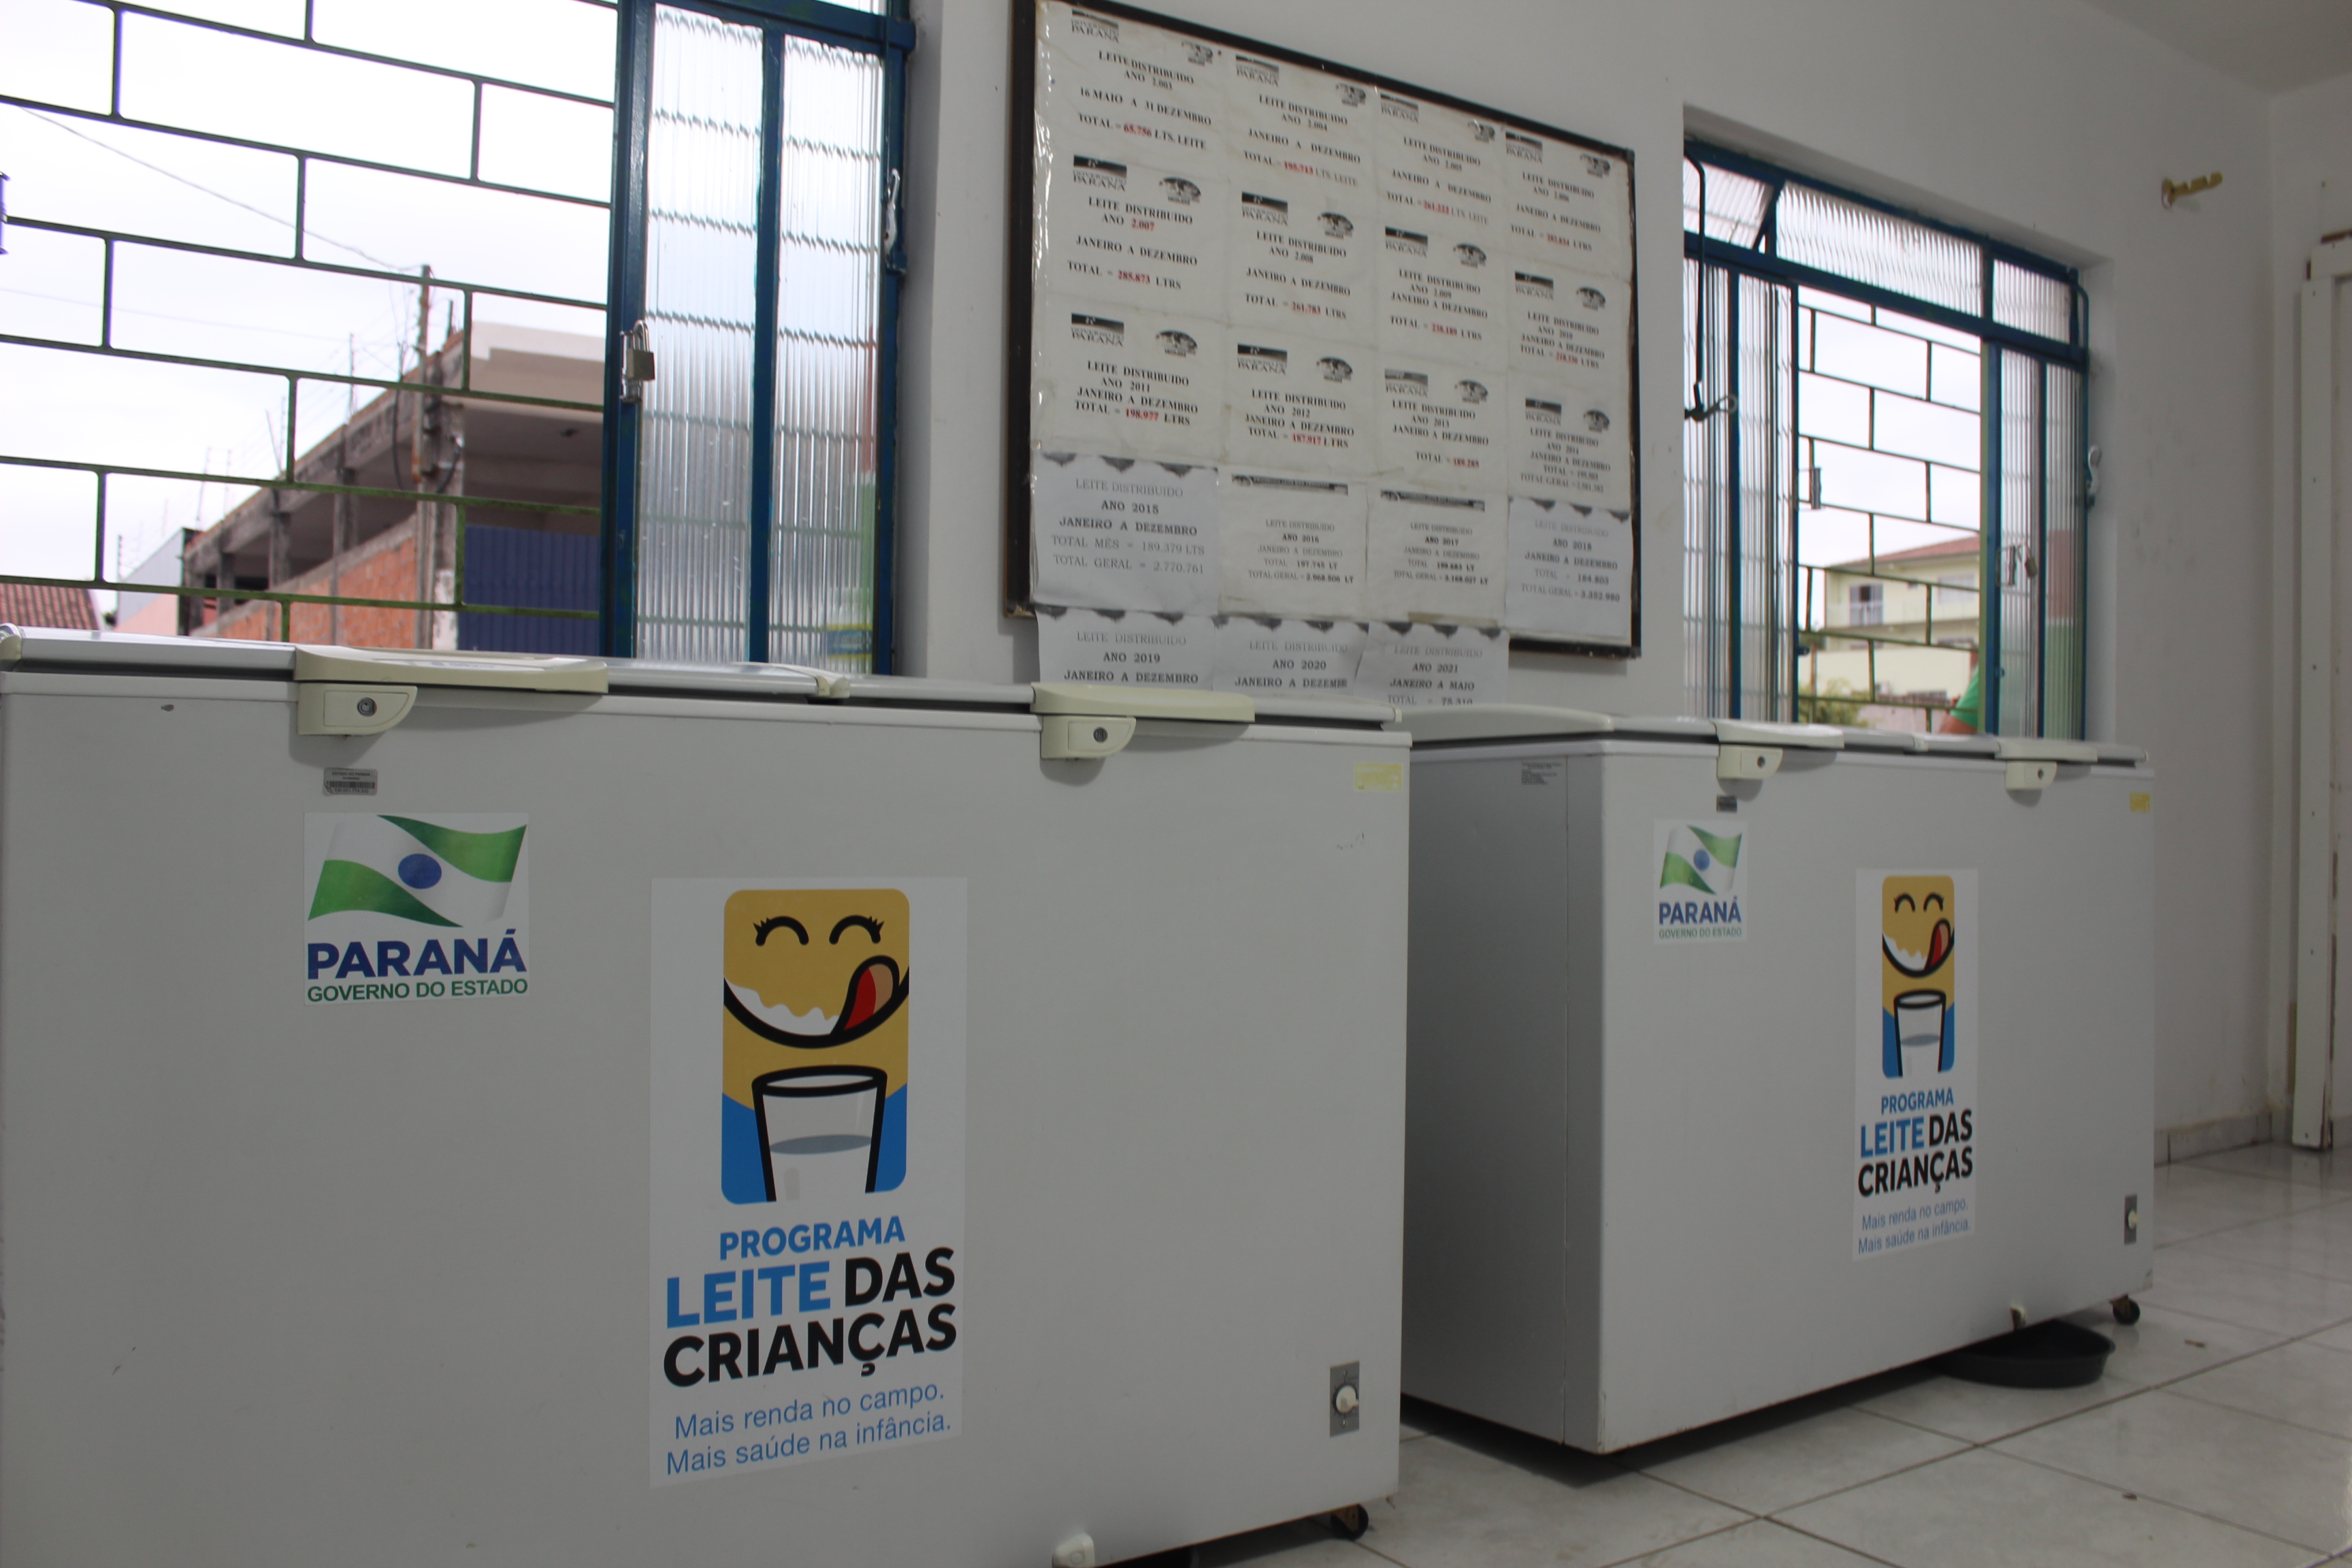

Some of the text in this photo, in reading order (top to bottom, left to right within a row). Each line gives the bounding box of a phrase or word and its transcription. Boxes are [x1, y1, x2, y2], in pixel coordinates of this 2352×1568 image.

[1099, 50, 1194, 84] LEITE DISTRIBUIDO
[1125, 70, 1172, 91] ANO 2.003
[1081, 86, 1211, 125] 16 MAIO 31 DEZEMBRO
[1260, 94, 1348, 125] LEITE DISTRIBUIDO
[1078, 112, 1113, 129] TOTAL
[1178, 135, 1206, 150] LEITE
[1282, 113, 1328, 131] ANO 2.004
[1248, 129, 1360, 163] JANEIRO DEZEMBRO
[1243, 150, 1275, 166] TOTAL
[1423, 154, 1439, 165] ANO
[1089, 196, 1193, 225] LEITE DISTRIBUIDO
[1102, 213, 1155, 231] ANO 2.007
[1076, 235, 1197, 266] JANEIRO DEZEMBRO
[1257, 230, 1347, 258] LEITE DISTRIBUIDO
[1269, 246, 1313, 264] ANO 2.008
[1067, 260, 1102, 276] TOTAL
[1156, 276, 1181, 289] LTRS
[1247, 267, 1350, 297] JANEIRO DEZEMBRO
[1399, 268, 1422, 282] LEITE
[1411, 284, 1428, 294] ANO
[1245, 293, 1277, 306] TOTAL
[1391, 292, 1428, 307] JANEIRO
[1390, 315, 1420, 329] TOTAL
[1088, 360, 1189, 387] LEITE DISTRIBUIDO
[1102, 377, 1150, 393] ANO 2011
[1077, 387, 1198, 414] JANEIRO DEZEMBRO
[1252, 388, 1345, 410] LEITE DISTRIBUIDO
[1075, 399, 1109, 414] TOTAL
[1164, 413, 1190, 426] LTRS
[1265, 404, 1310, 419] ANO 2012
[1392, 399, 1475, 420] LEITE DISTRIBUIDO
[1245, 413, 1354, 437] JANEIRO DEZEMBRO
[1411, 415, 1450, 428] ANO 2013
[1248, 427, 1348, 448] TOTAL LTRS
[1393, 425, 1488, 446] JANEIRO DEZEMBRO
[1416, 452, 1442, 463] TOTAL
[1076, 478, 1183, 497] LEITE DISTRIBUIDO
[1102, 500, 1158, 514] ANO 2015
[1060, 517, 1197, 536] JANEIRO A DEZEMBRO
[1266, 519, 1287, 528] LEITE
[1051, 535, 1088, 547] TOTAL
[1095, 538, 1120, 549] MÊS
[1186, 545, 1205, 555] LTS
[1283, 533, 1319, 544] ANO 2016
[1425, 536, 1458, 546] ANO 2017
[1553, 538, 1592, 551] ANO 2018
[1054, 554, 1088, 567] TOTAL
[1094, 558, 1132, 570] GERAL
[1264, 558, 1288, 567] TOTAL
[1525, 551, 1618, 570] JANEIRO DEZEMBRO
[1248, 569, 1272, 579] TOTAL
[1077, 632, 1186, 646] LEITE DISTRIBUIDO
[1103, 651, 1160, 664] ANO 2019
[1273, 659, 1326, 670] ANO 2020
[1064, 670, 1198, 685] JANEIRO A DEZEMBRO
[1413, 663, 1458, 673] ANO 2021
[1235, 676, 1296, 687] JANEIRO A
[1390, 678, 1475, 691] JANEIRO MAIO
[1388, 694, 1417, 705] TOTAL
[1659, 895, 1742, 925] PARANÁ
[1659, 927, 1742, 939] GOVERNO DO ESTADO
[307, 928, 527, 979] PARANÁ
[308, 979, 528, 1002] GOVERNO DO ESTADO
[1881, 1087, 1954, 1115] PROGRAMA
[1861, 1108, 1972, 1158] LEITE DAS
[1858, 1145, 1973, 1197] CRIANÇAS
[1862, 1198, 1968, 1231] Mais renda no campo.
[720, 1215, 905, 1260] PROGRAMA
[1859, 1218, 1970, 1254] Mais saúde na infância.
[666, 1247, 955, 1328] LEITE DAS
[663, 1303, 957, 1388] CRIANÇAS
[675, 1384, 944, 1439] Mais renda no campo.
[667, 1414, 951, 1475] Mais saúde na infância.
